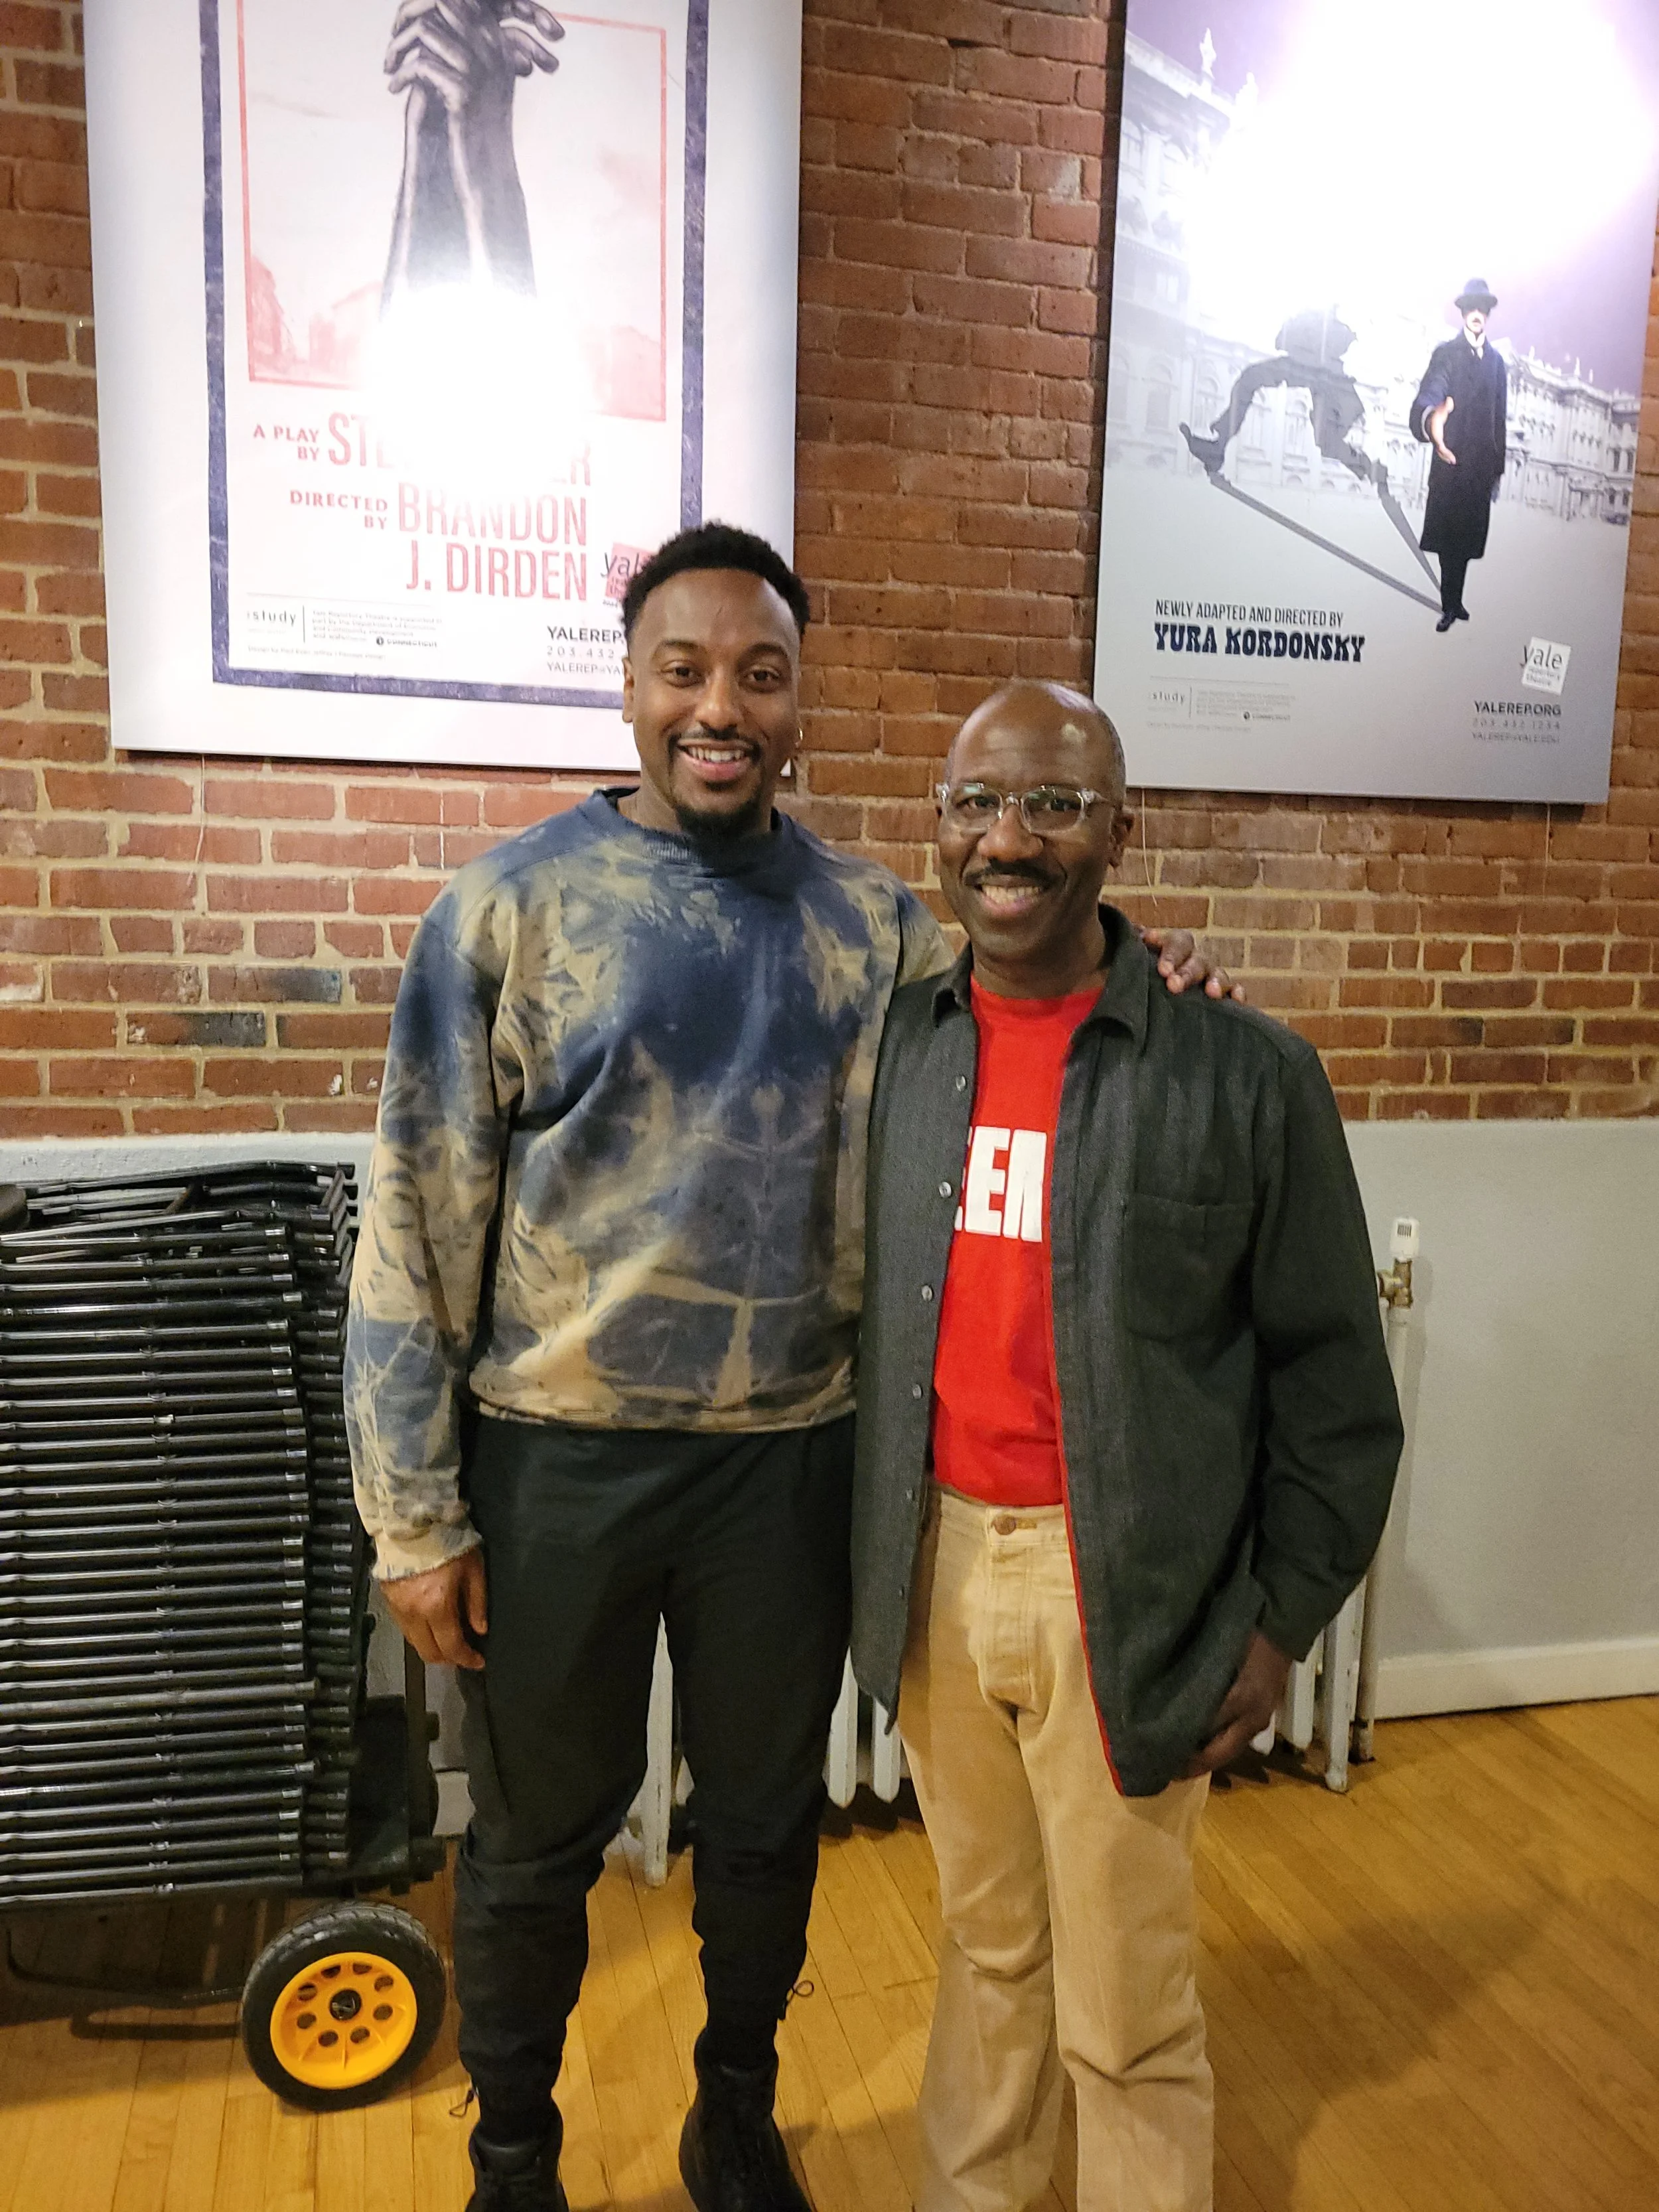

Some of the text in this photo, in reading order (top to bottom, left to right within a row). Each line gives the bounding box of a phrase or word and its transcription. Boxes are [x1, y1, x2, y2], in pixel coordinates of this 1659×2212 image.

[253, 423, 319, 443] A PLAY
[297, 445, 319, 461] BY
[289, 489, 388, 512] DIRECTED
[398, 482, 587, 546] BRANDON
[364, 514, 387, 530] BY
[406, 540, 587, 601] J. DIRDEN
[1155, 599, 1344, 628] NEWLY ADAPTED AND DIRECTED BY
[1154, 622, 1365, 662] YURA KORDONSKY
[1520, 644, 1562, 670] yale
[954, 1126, 1047, 1243] ER
